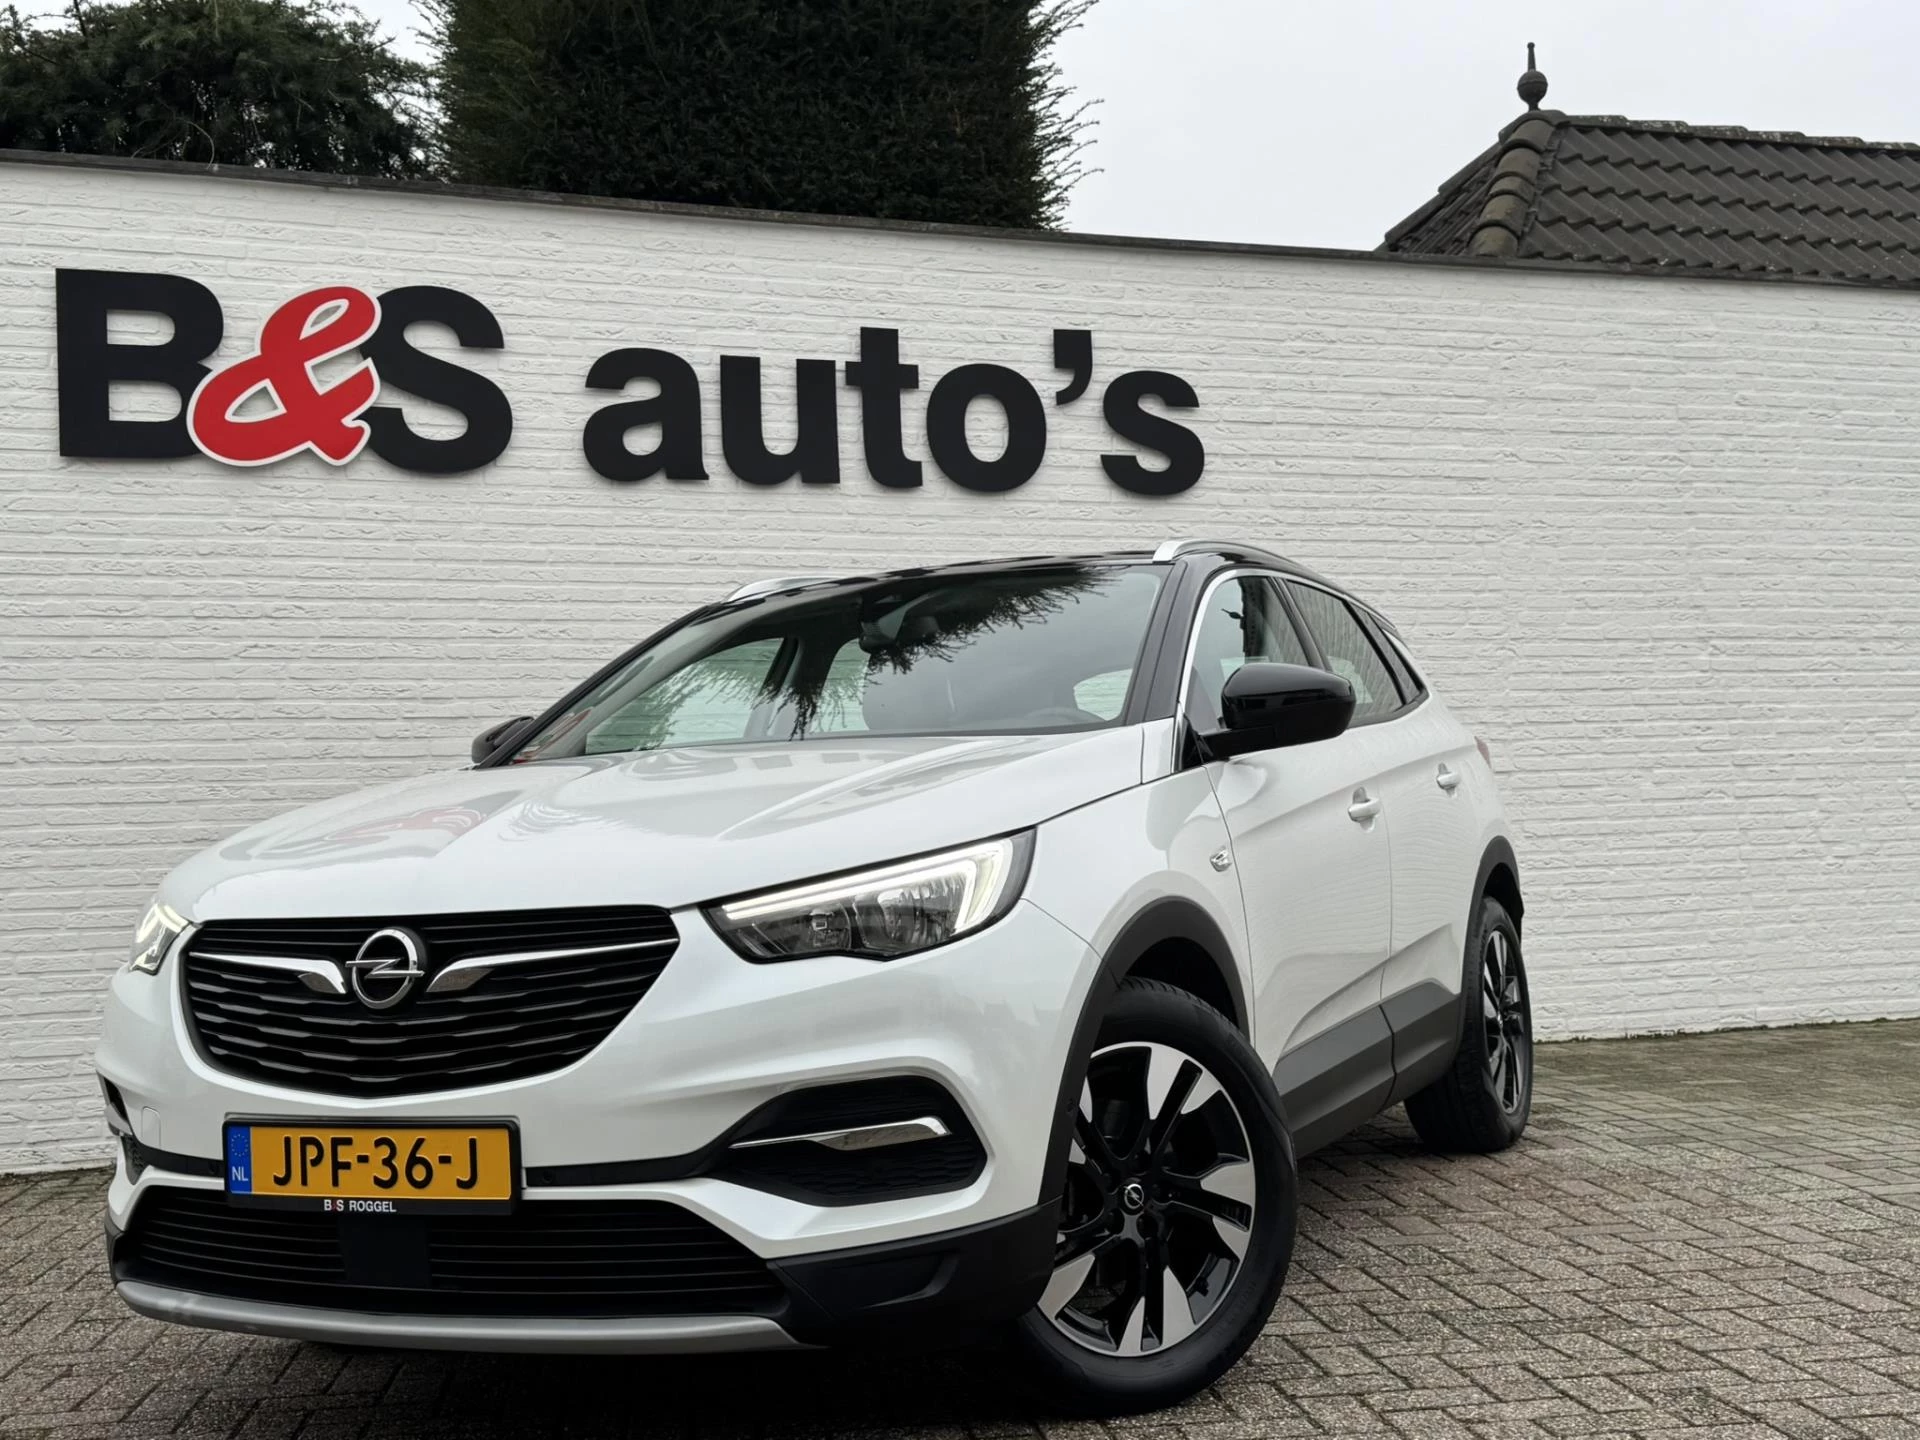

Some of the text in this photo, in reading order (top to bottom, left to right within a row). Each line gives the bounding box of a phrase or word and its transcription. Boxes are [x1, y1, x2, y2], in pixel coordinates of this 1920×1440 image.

[55, 267, 1206, 496] B&S auto's
[231, 1165, 249, 1182] NL
[273, 1135, 479, 1190] JPF-36-J
[323, 1199, 397, 1213] BS ROGGEL
